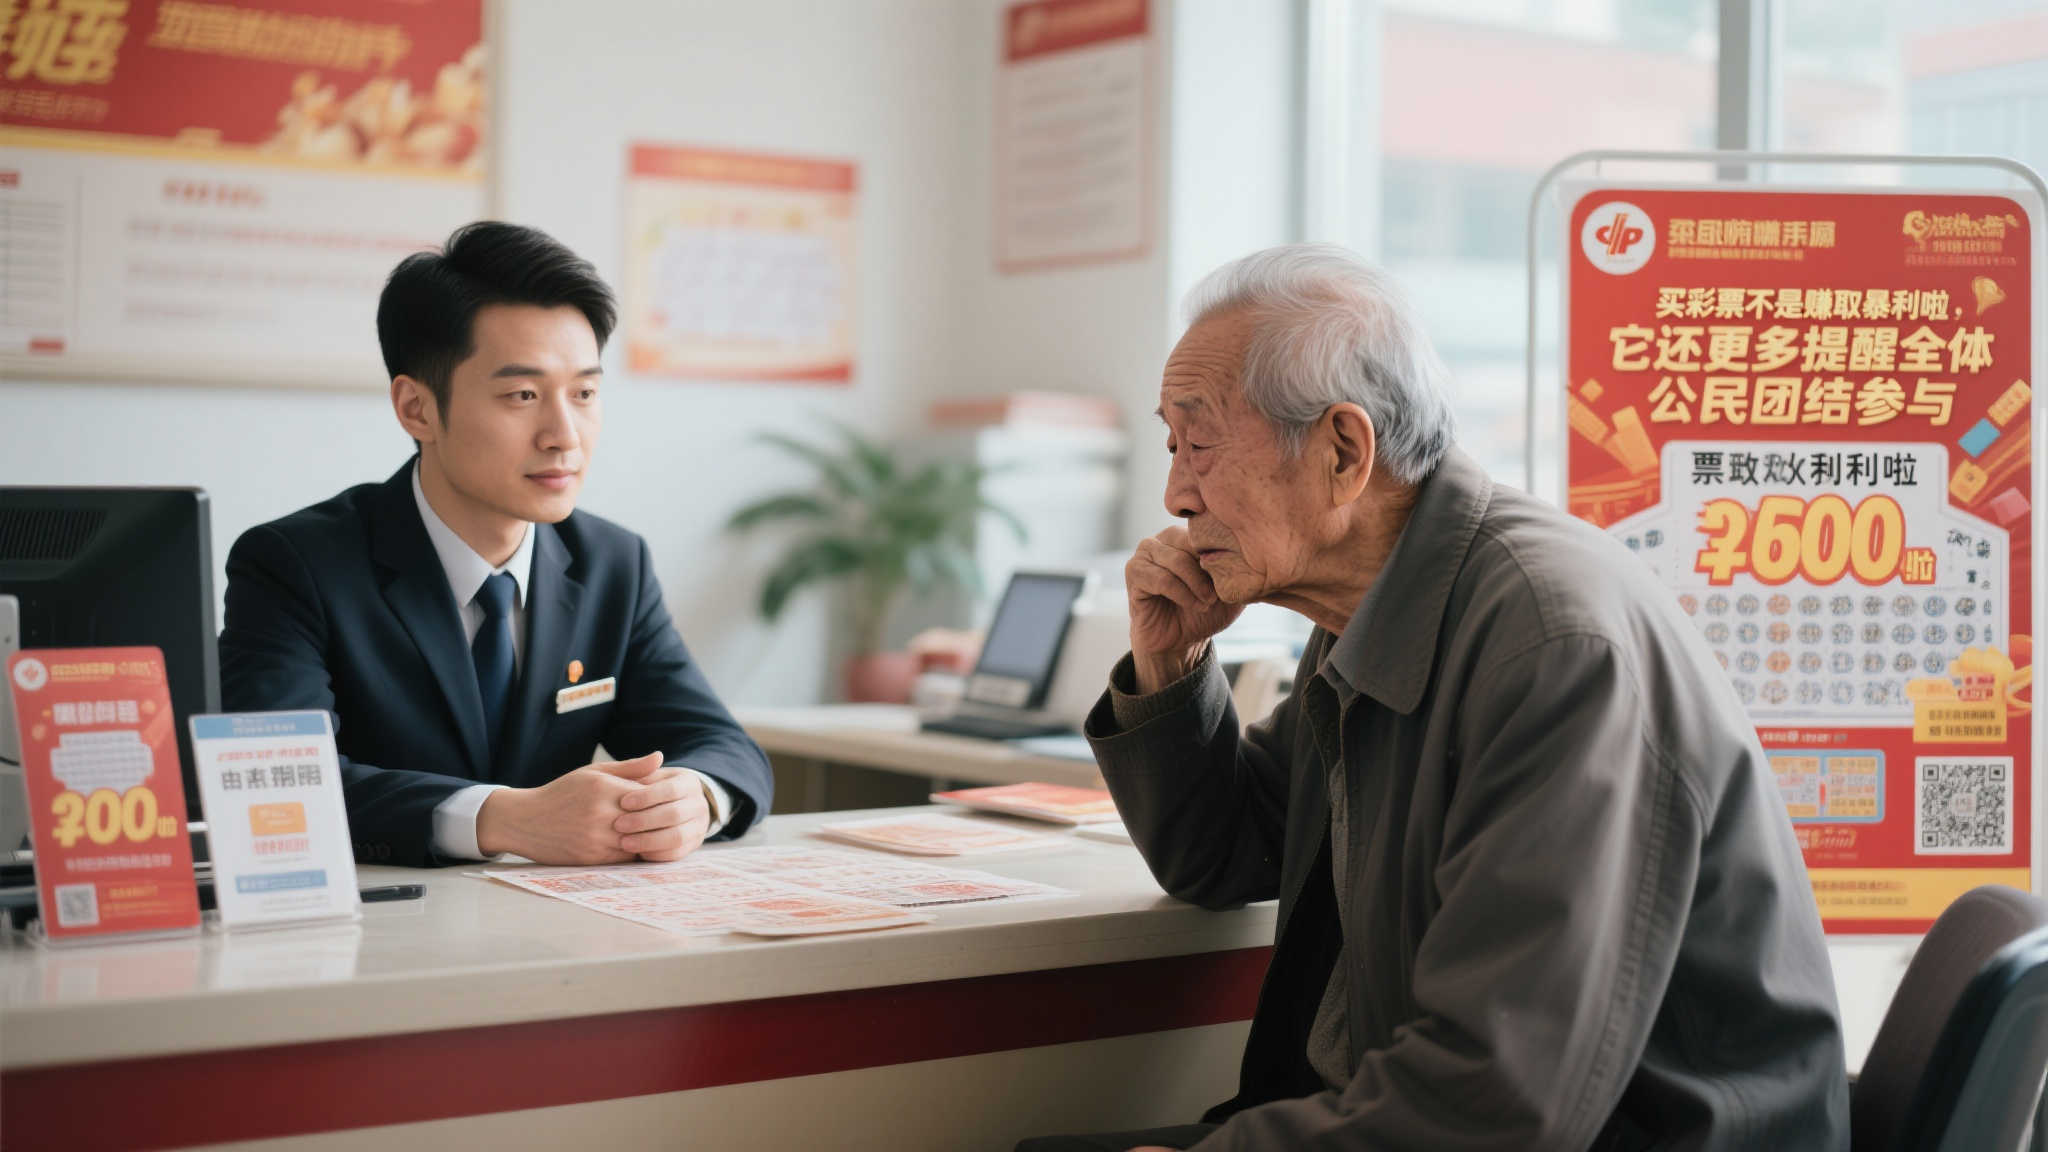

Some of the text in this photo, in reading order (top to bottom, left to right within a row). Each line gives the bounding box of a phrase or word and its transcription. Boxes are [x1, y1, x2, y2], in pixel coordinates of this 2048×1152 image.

[1609, 325, 1995, 374] 它还更多提醒全体
[1647, 376, 1957, 426] 公民团结参与
